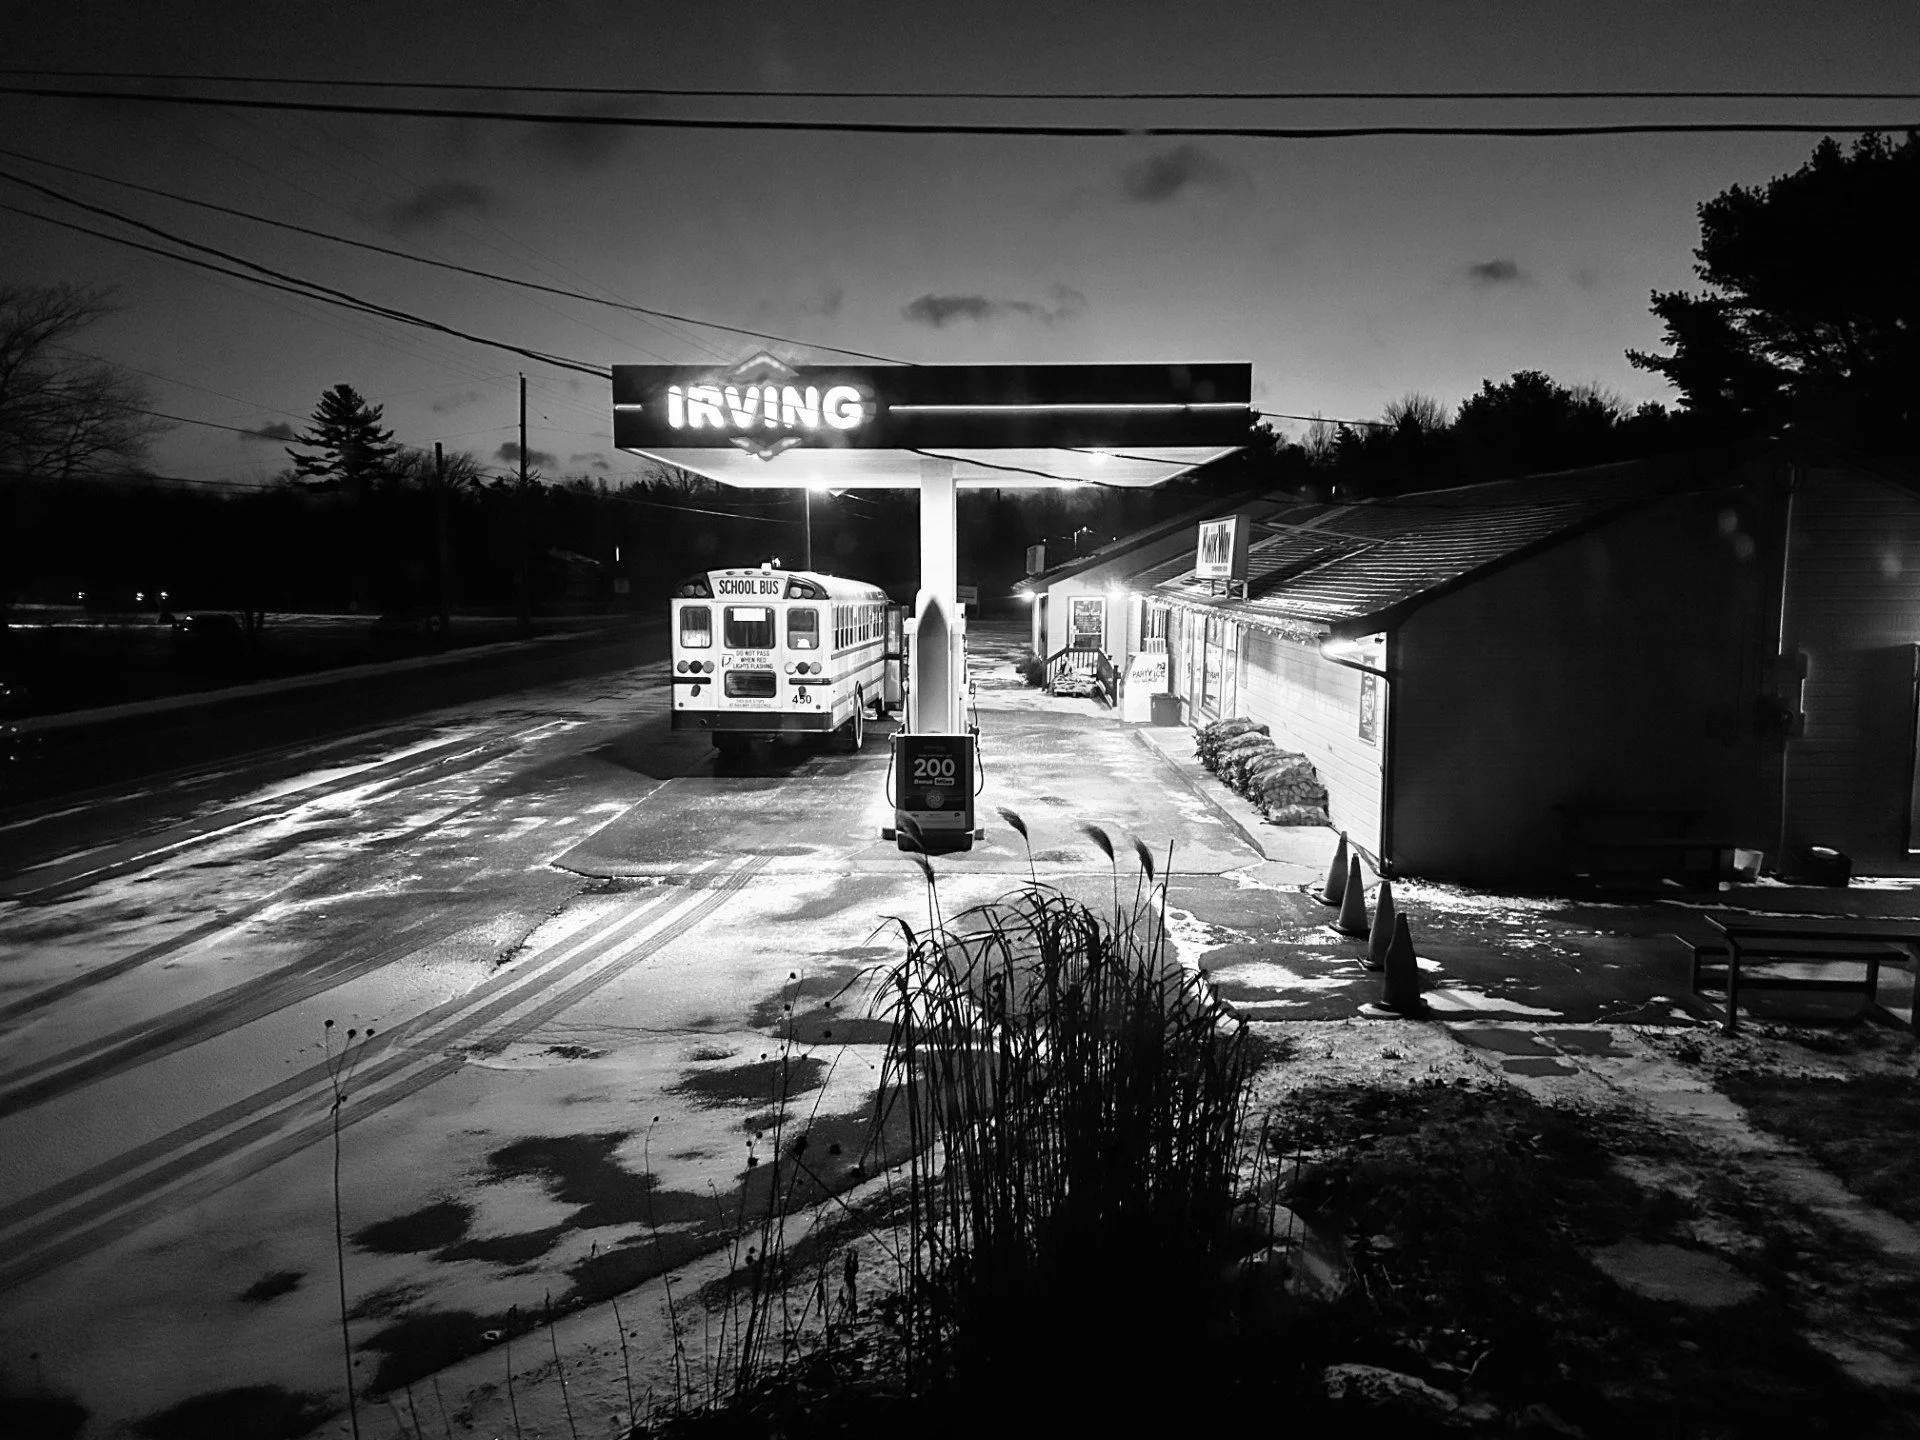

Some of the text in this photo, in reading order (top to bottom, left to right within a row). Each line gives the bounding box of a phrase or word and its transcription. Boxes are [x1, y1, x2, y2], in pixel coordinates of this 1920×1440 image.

[668, 385, 864, 429] IRVING
[719, 579, 779, 594] SCHOOL BUS
[1132, 669, 1166, 678] PARTY ICE
[792, 694, 812, 704] 450
[914, 758, 955, 777] 200
